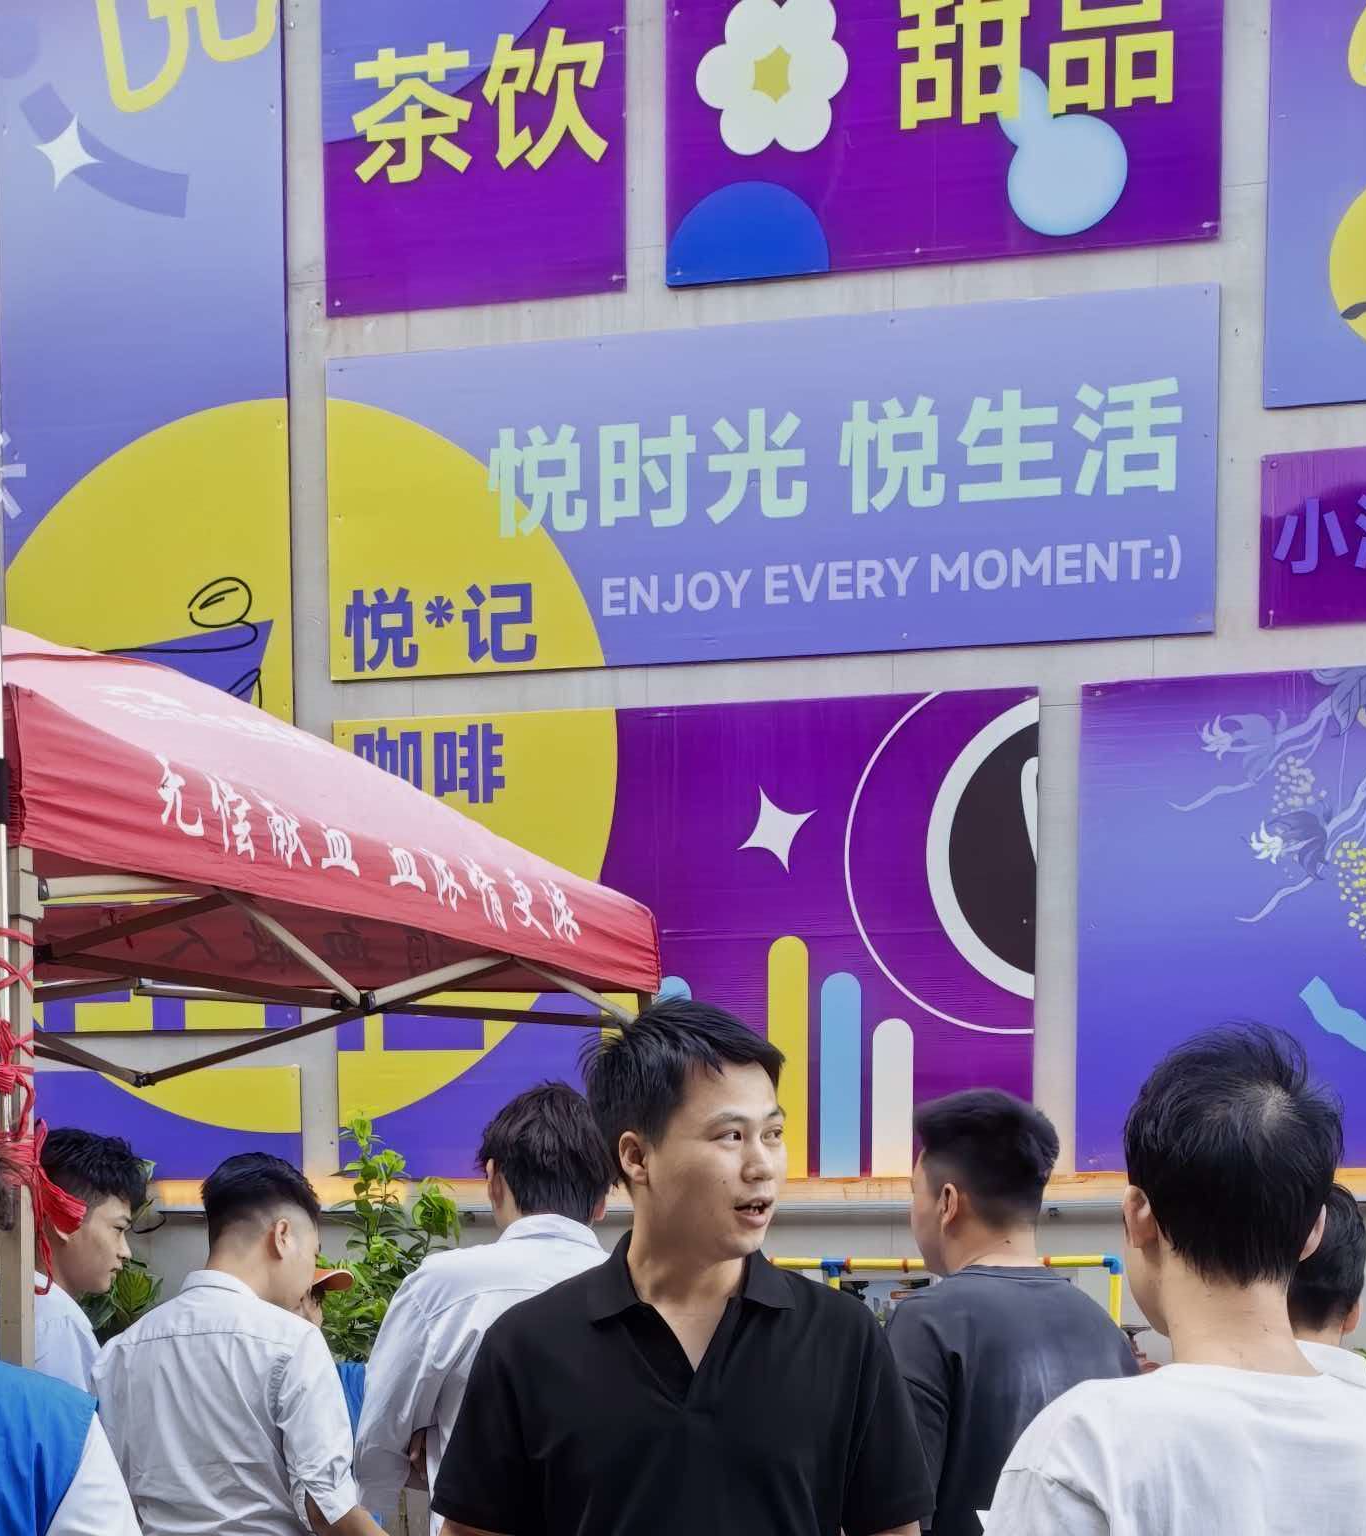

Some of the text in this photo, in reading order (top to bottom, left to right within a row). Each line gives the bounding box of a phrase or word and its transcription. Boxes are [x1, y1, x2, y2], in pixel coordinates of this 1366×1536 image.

[351, 28, 609, 185] 茶饮
[898, 0, 1174, 131] 甜品
[488, 377, 1182, 537] 悦时光 悦生活
[601, 536, 1182, 617] ENJOY EVERY MOMENT:)
[354, 723, 505, 803] 咖啡
